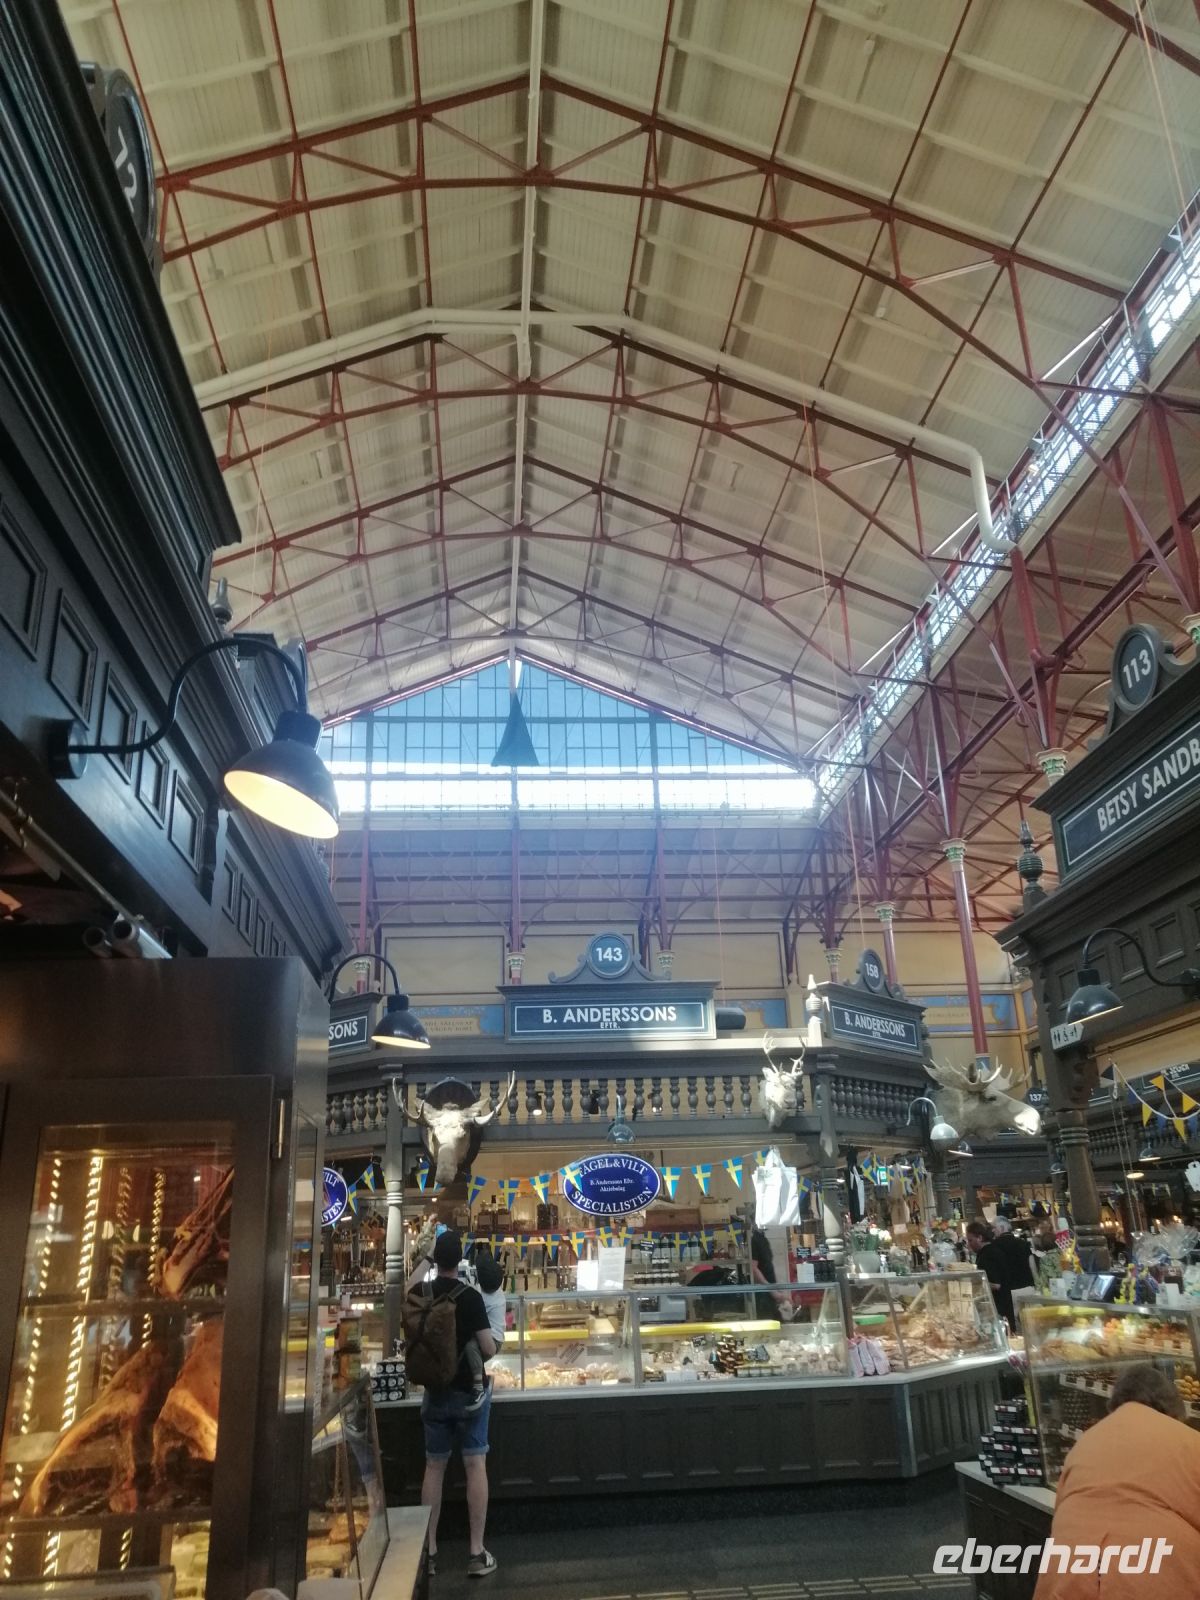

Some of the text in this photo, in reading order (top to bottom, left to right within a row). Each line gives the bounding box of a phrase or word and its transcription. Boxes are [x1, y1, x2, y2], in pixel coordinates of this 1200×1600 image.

[1123, 649, 1151, 689] 113
[1097, 738, 1200, 832] BETSY SANDB
[596, 947, 623, 962] 143
[865, 963, 879, 979] 158
[543, 1006, 677, 1024] B. ANDERSSONS
[844, 1012, 905, 1037] B. ANDERSSONS
[329, 1020, 358, 1040] SONS
[1029, 1093, 1042, 1102] 137
[572, 1186, 653, 1213] SPECIALISTEN
